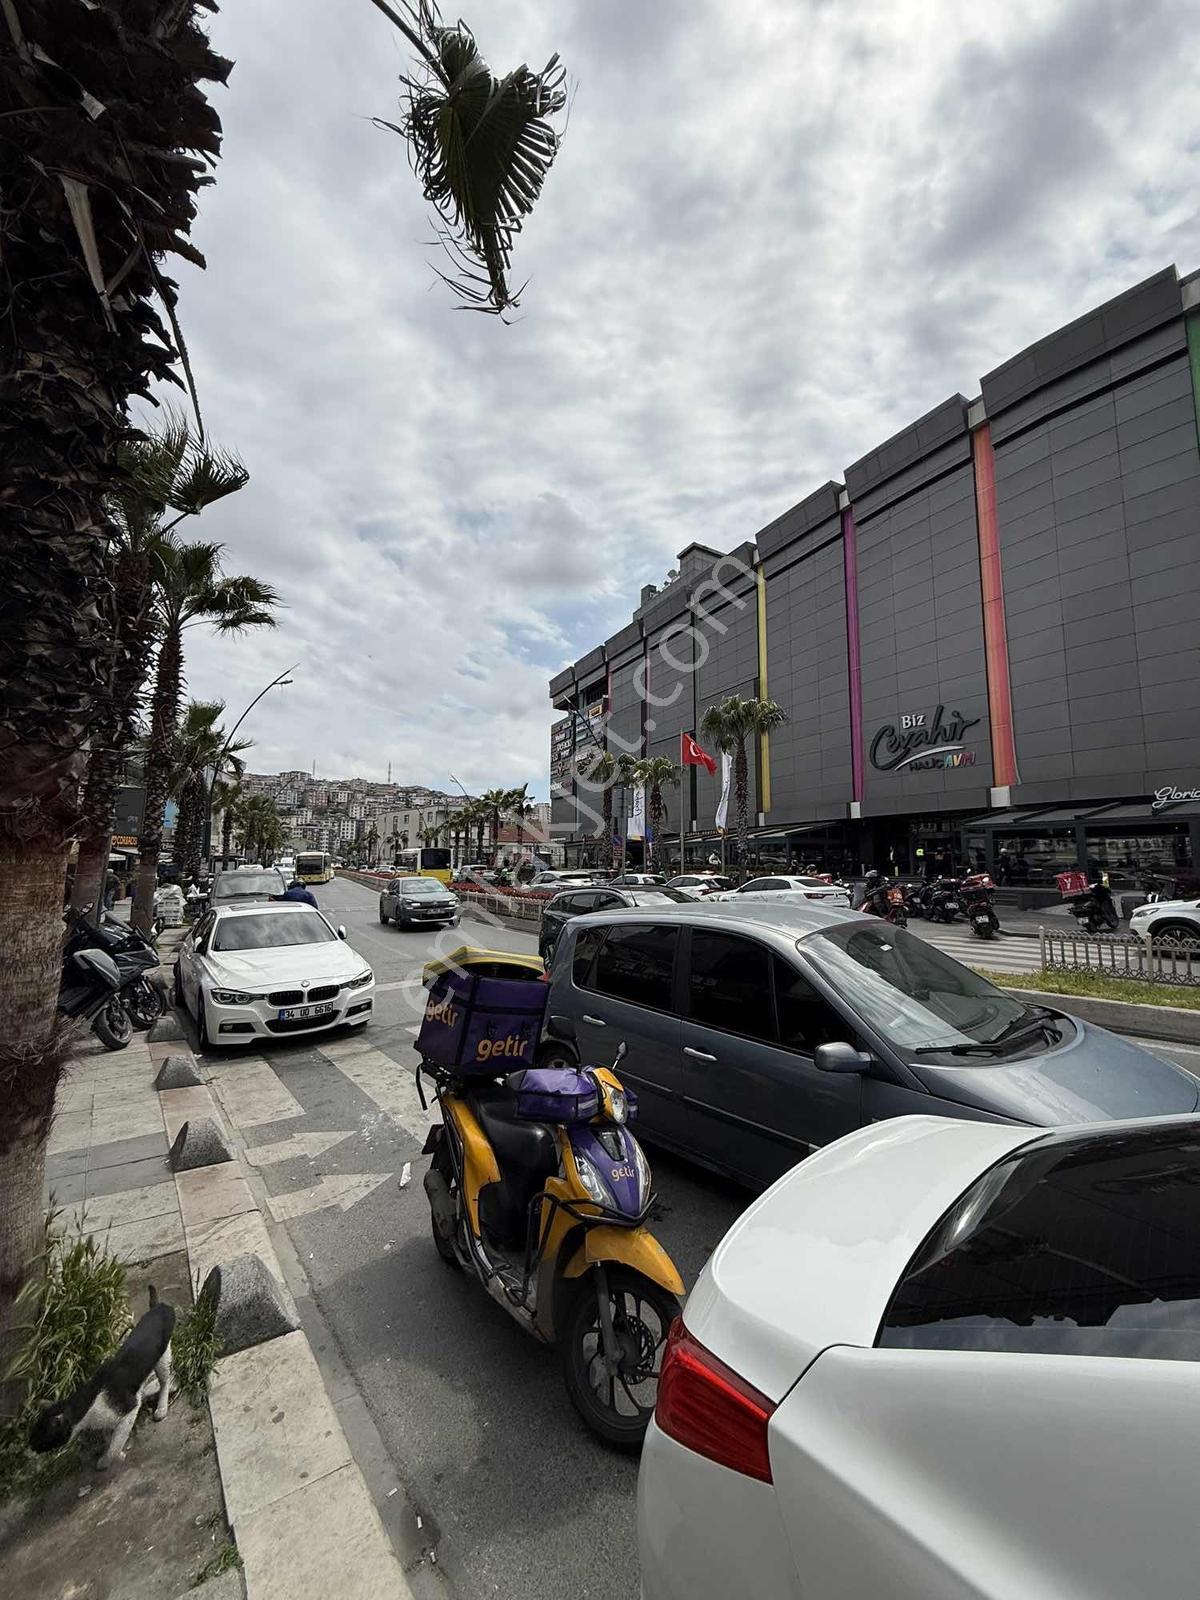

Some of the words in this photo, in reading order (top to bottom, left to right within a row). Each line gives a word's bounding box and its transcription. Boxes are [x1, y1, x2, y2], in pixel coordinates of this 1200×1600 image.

[870, 704, 981, 771] Cevahir
[285, 1010, 295, 1019] 34
[425, 1000, 459, 1028] getir
[476, 1034, 528, 1061] getir
[611, 1165, 635, 1181] getir
